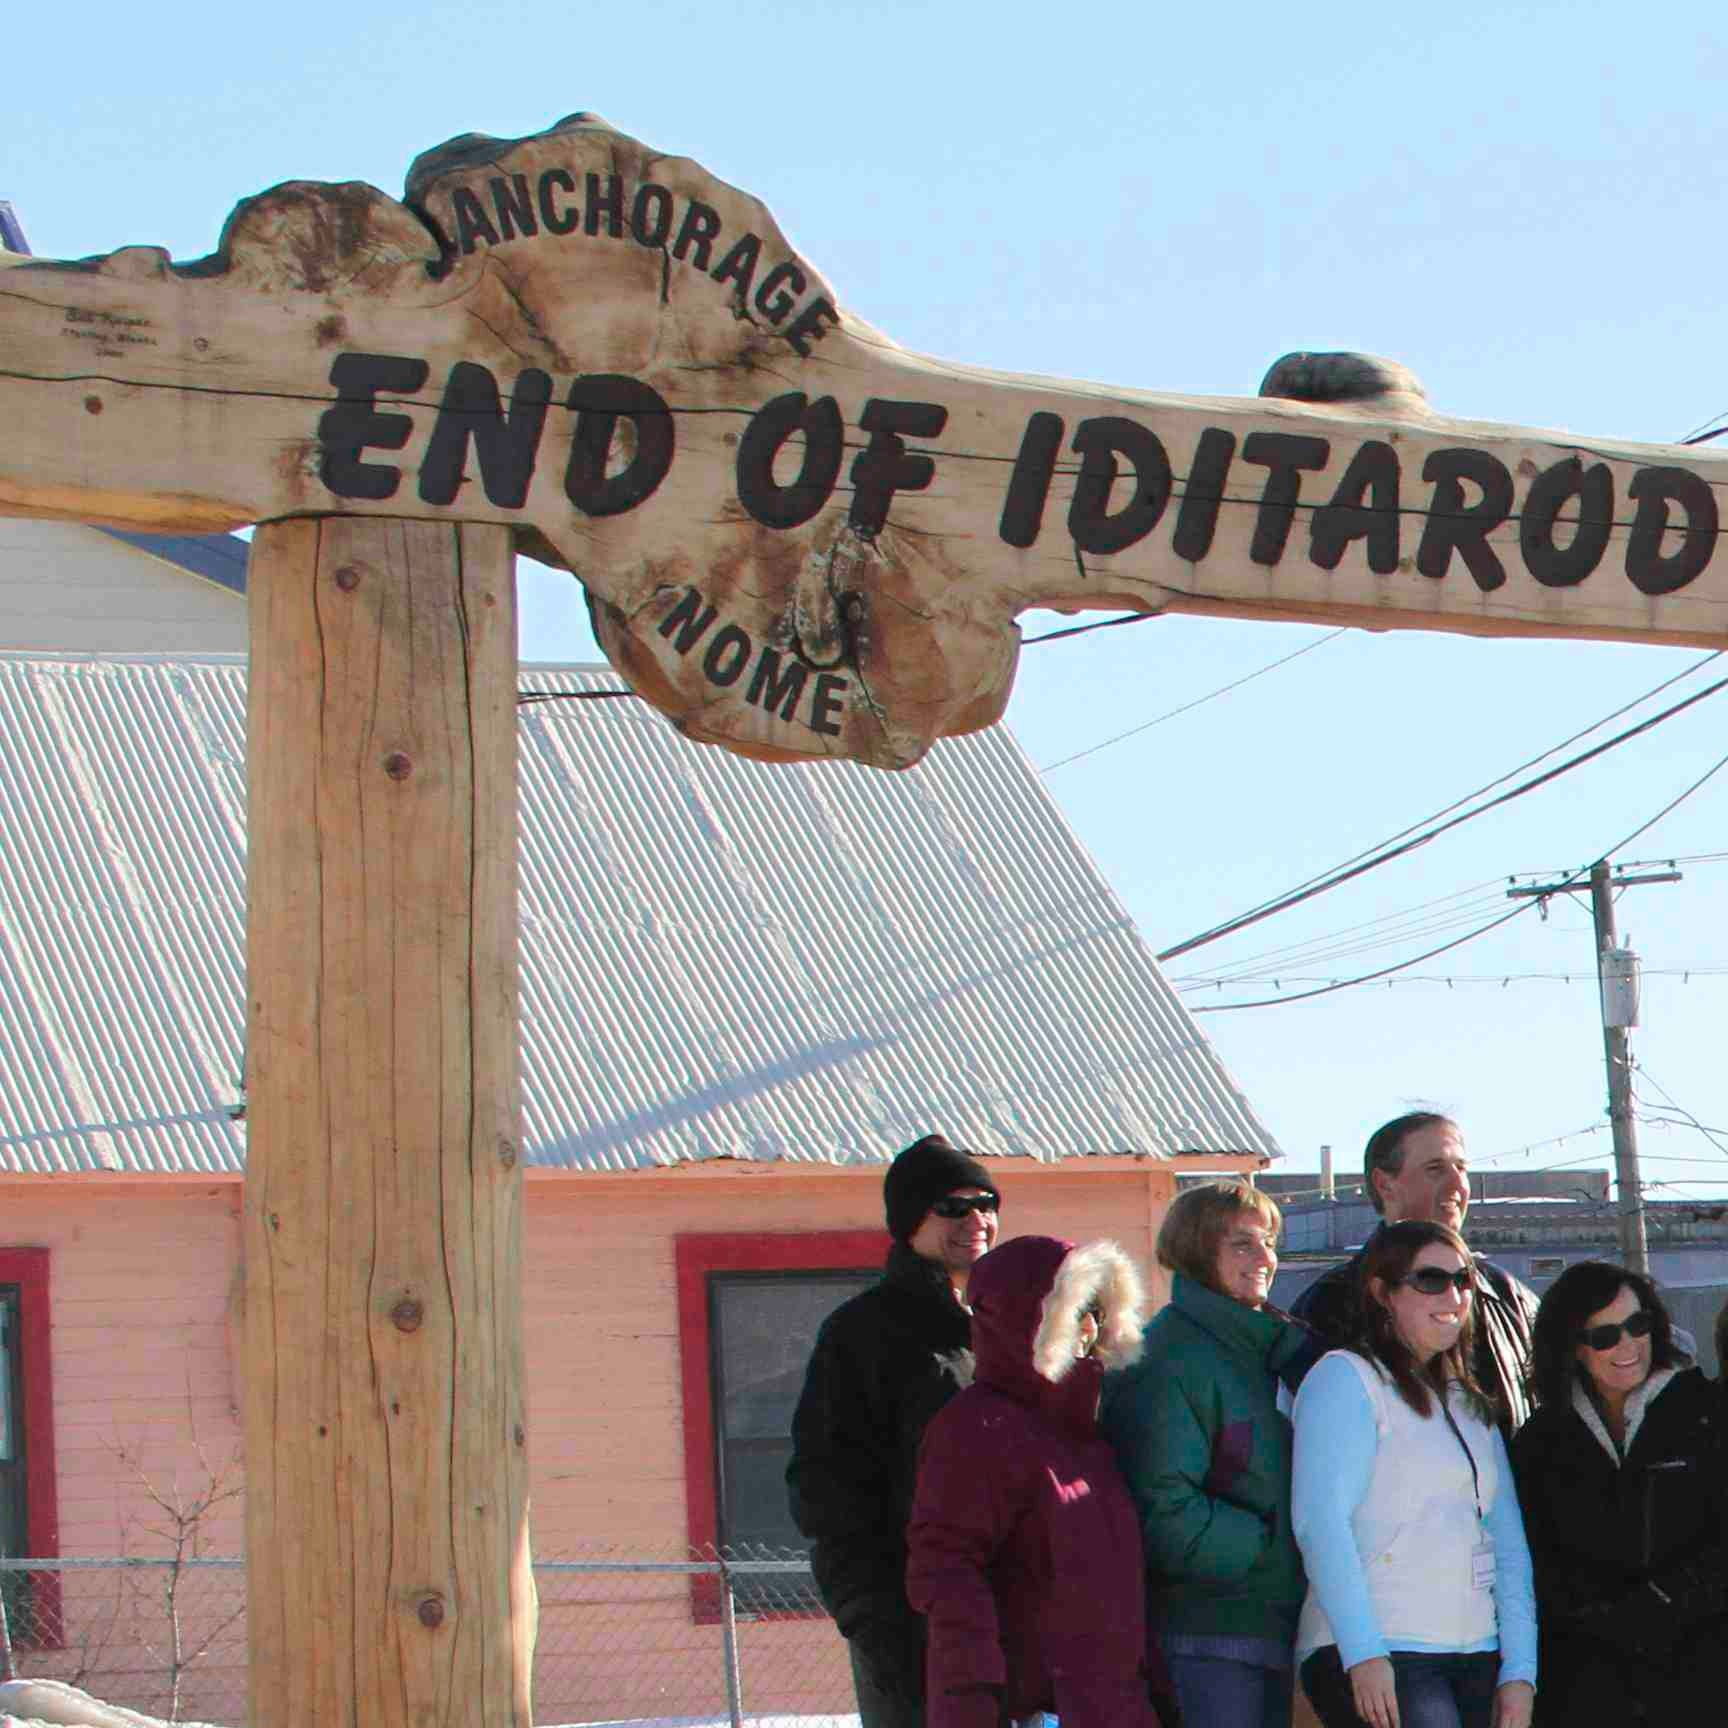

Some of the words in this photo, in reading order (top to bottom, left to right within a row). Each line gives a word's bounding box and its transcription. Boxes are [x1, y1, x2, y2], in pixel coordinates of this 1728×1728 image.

[451, 168, 839, 357] ANCHORAGE
[319, 352, 675, 517] END
[736, 391, 948, 541] OF
[1000, 411, 1719, 595] IDITAROD
[657, 589, 848, 737] NOME
